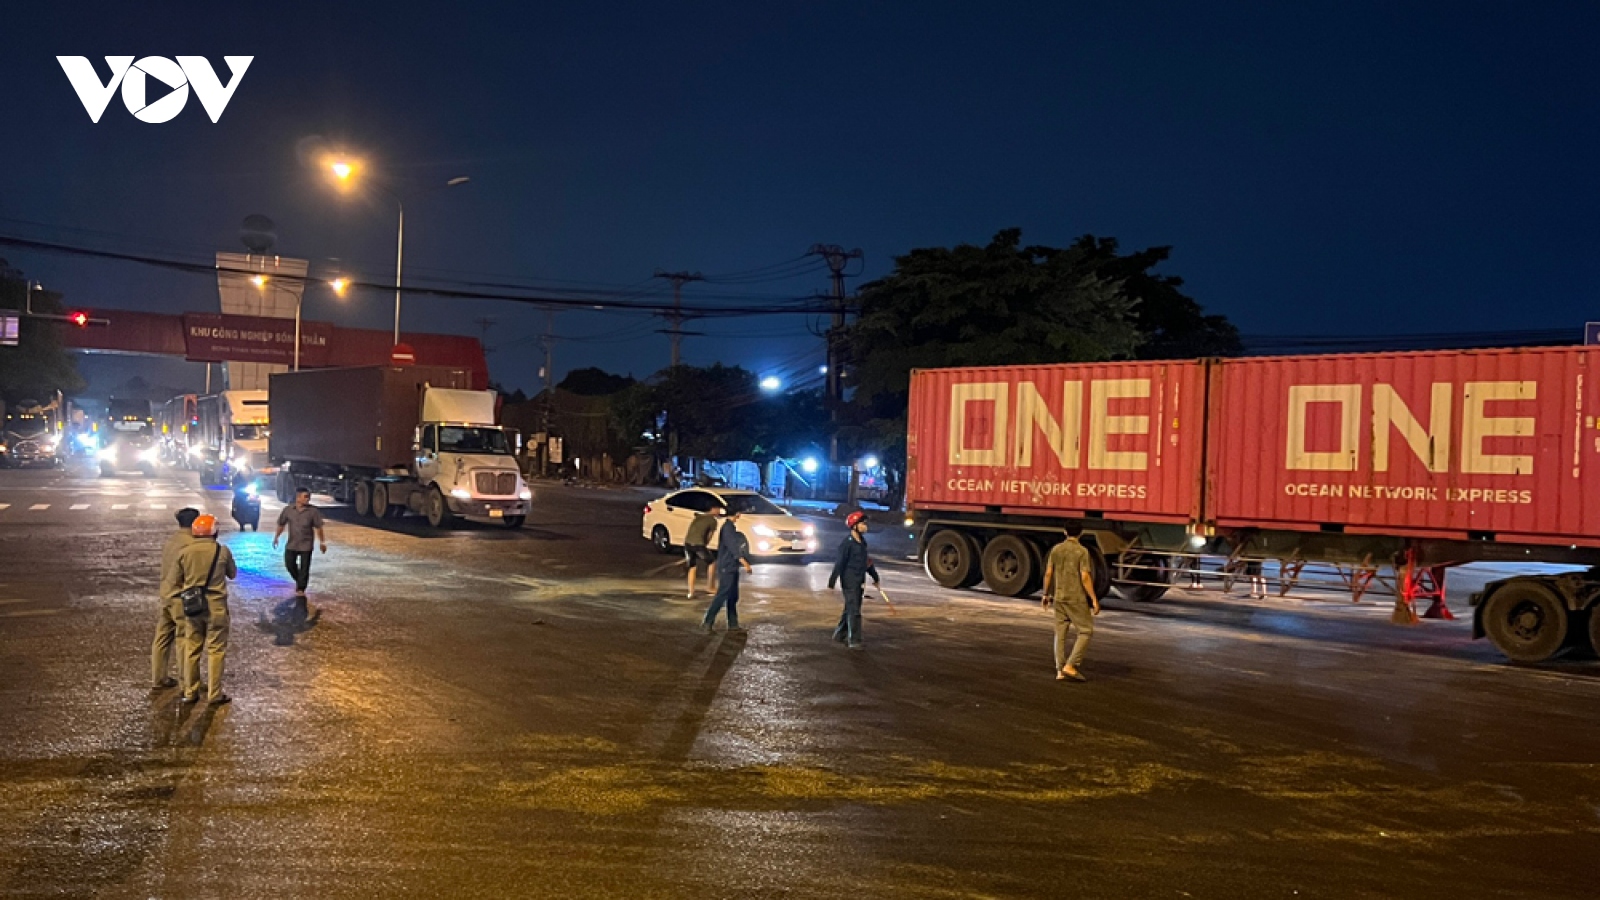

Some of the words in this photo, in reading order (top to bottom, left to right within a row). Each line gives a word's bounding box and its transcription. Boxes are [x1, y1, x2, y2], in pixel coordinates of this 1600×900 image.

[190, 327, 210, 337] KHU
[275, 331, 293, 343] SÓN
[949, 379, 1150, 471] ONE
[1286, 381, 1537, 475] ONE
[947, 478, 994, 492] OCEAN
[1001, 480, 1071, 497] NETWORK
[1076, 483, 1147, 499] EXPRESS
[1284, 482, 1343, 498] OCEAN
[1348, 485, 1438, 501] NETWORK
